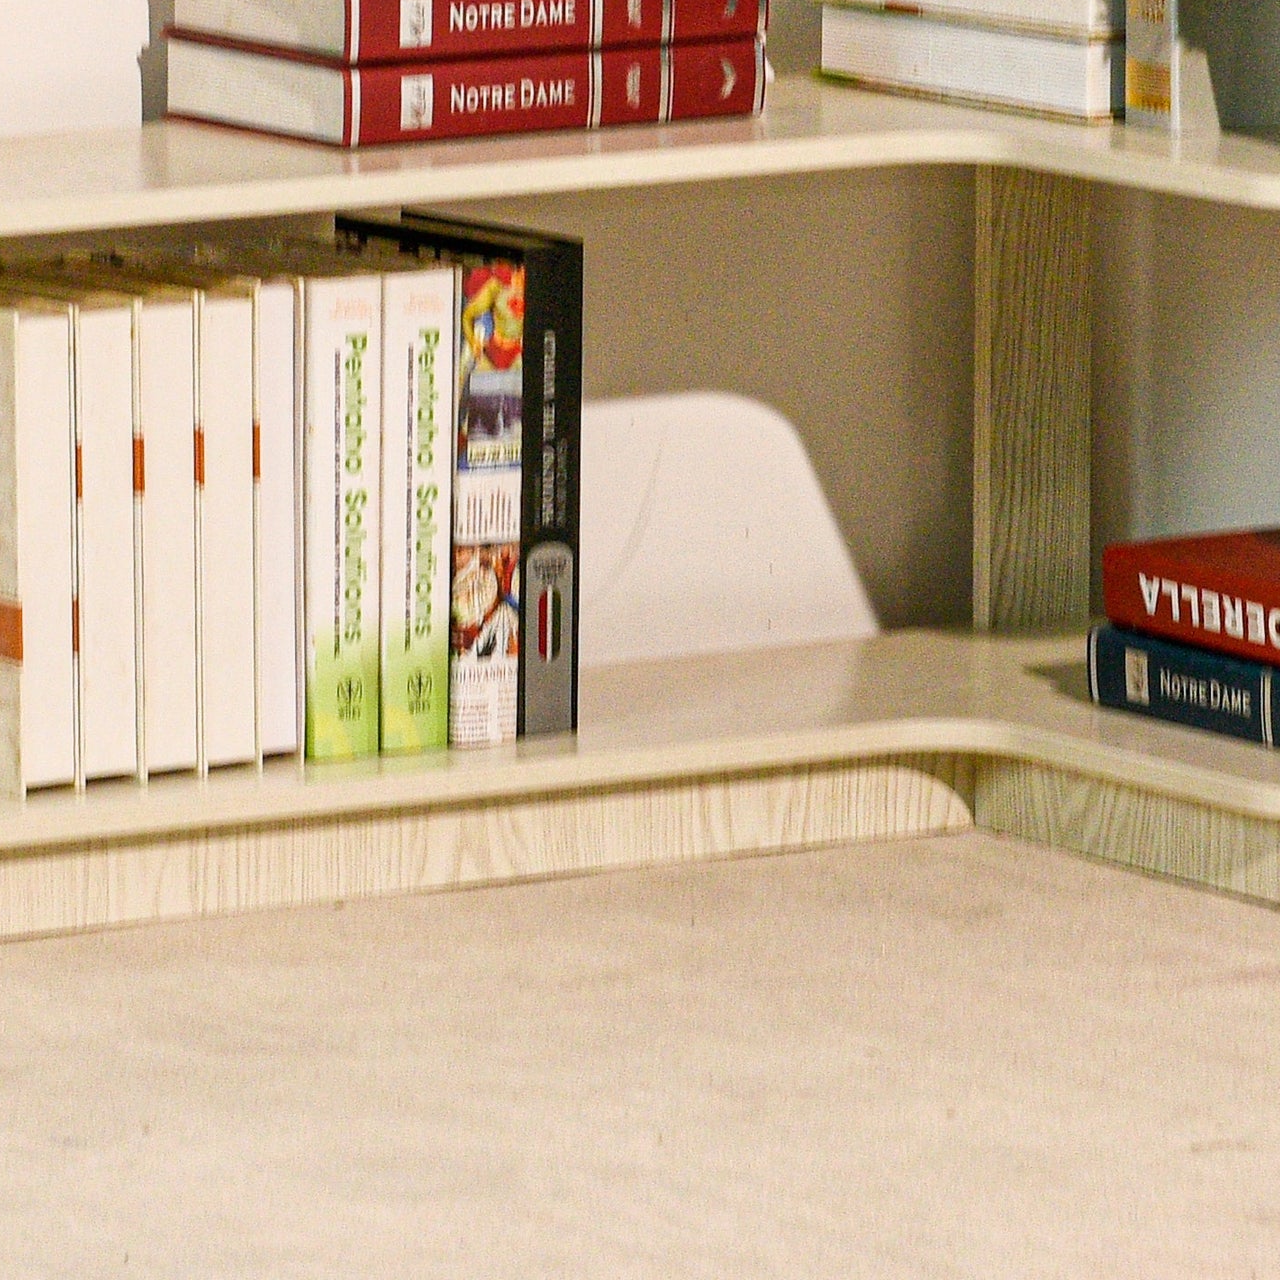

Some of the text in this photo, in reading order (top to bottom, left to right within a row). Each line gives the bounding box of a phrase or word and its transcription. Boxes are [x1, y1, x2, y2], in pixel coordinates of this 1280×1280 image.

[449, 0, 515, 33] NOTRE
[450, 76, 576, 114] NOTRE DAME
[342, 487, 368, 644] Solutions
[414, 482, 440, 639] Solutions
[1159, 667, 1252, 718] NOTRE DAME
